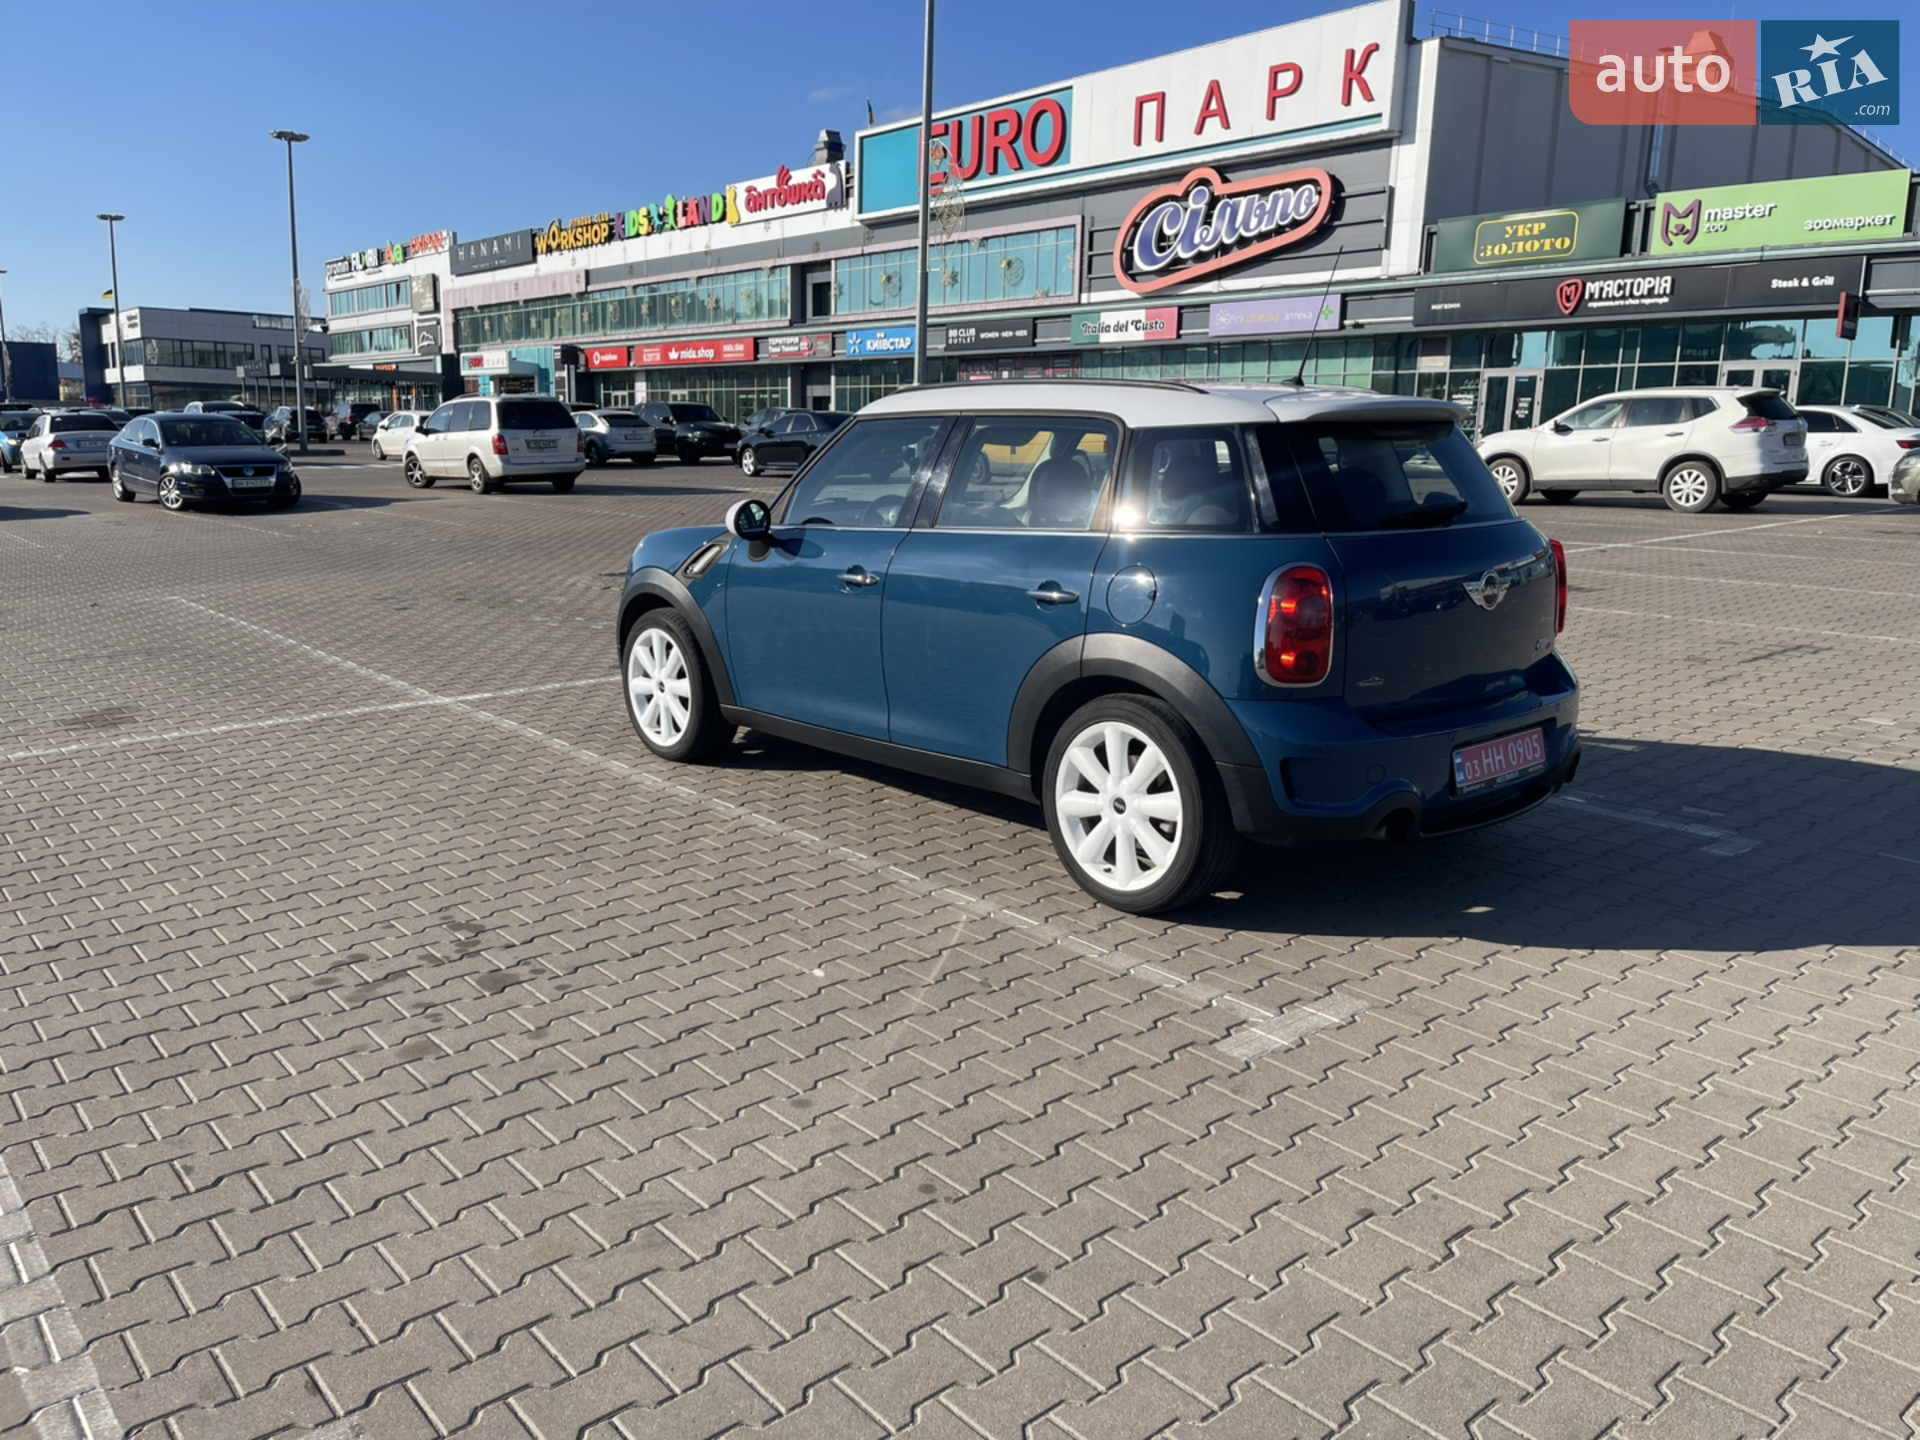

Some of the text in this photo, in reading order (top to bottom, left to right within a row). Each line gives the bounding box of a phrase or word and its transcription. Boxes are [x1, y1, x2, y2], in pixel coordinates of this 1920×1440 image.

[1133, 42, 1380, 147] ПАРК
[614, 192, 724, 240] KIDS LAND
[1704, 202, 1777, 223] master
[1804, 213, 1895, 232] зоомаркет
[1134, 186, 1319, 271] Сільпо
[1505, 222, 1547, 239] УКР
[1703, 222, 1727, 233] zoo
[458, 235, 521, 261] HANAMI
[535, 223, 609, 254] WORKSHOP
[1480, 236, 1571, 257] ЗОЛОТО
[1771, 276, 1835, 289] Steak & Grill
[958, 328, 976, 337] CLUB
[1081, 321, 1111, 336] Italia
[1112, 320, 1129, 333] del
[866, 332, 911, 351] КИЇВСТАР
[1464, 759, 1481, 779] 03
[1481, 744, 1507, 774] HH
[1508, 734, 1541, 766] 0905
